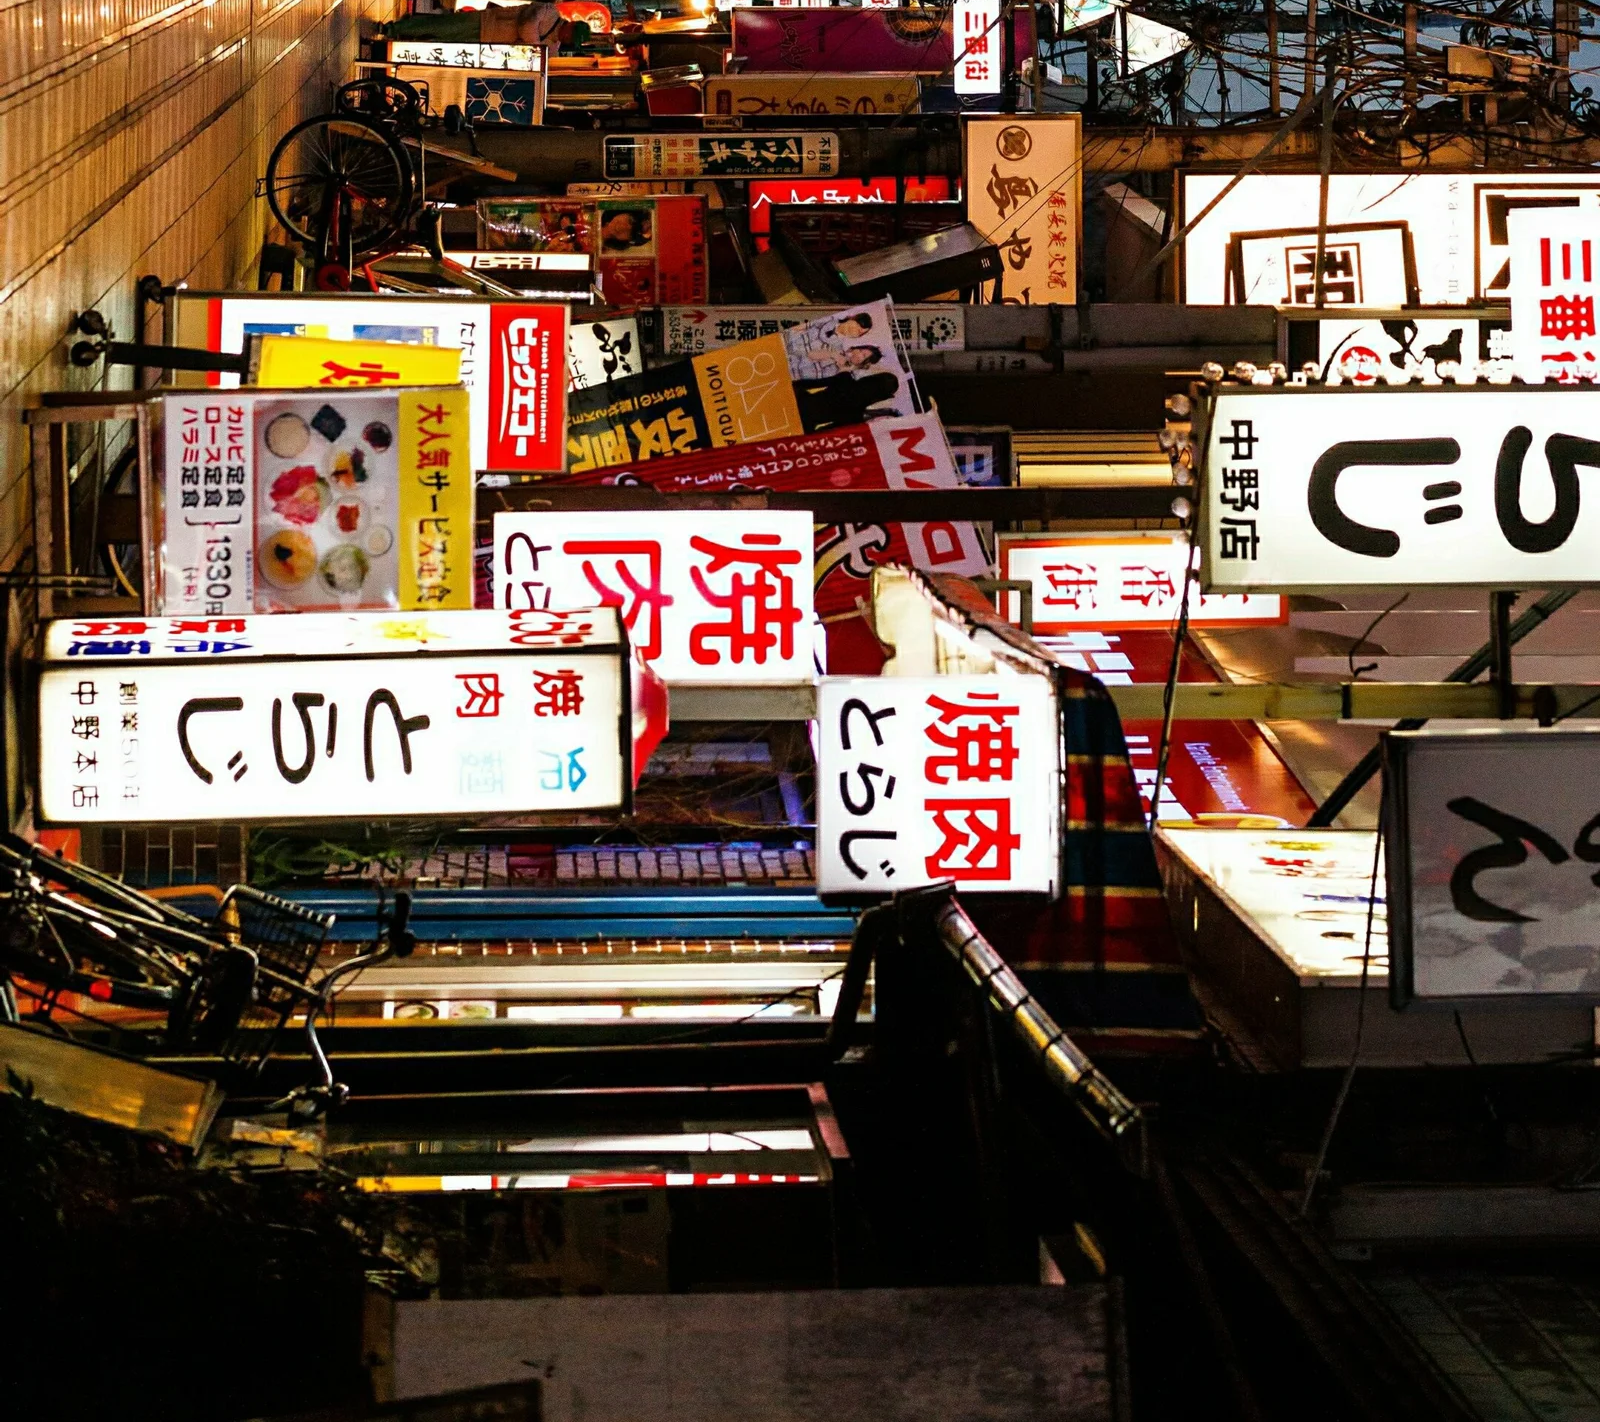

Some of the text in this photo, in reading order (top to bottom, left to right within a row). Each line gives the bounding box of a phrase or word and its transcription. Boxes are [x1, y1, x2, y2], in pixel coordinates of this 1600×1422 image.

[396, 48, 475, 68] 好味亭
[965, 12, 989, 81] 三番街
[708, 138, 800, 167] マツザキ
[819, 136, 832, 174] 不動産
[985, 164, 1039, 304] 鳥や
[508, 318, 539, 456] ビッグエコー
[539, 331, 550, 443] Karaoke Entertainment
[181, 407, 199, 509] ハラミ定食
[204, 406, 221, 509] ロース定食
[226, 406, 245, 509] カルビ定食
[416, 403, 451, 603] 大人気サービス定食
[1220, 420, 1259, 560] 中野店
[205, 535, 232, 616] 1330円
[563, 533, 803, 665] 焼肉
[1042, 564, 1251, 610] 番街
[70, 681, 100, 808] 中野本店
[177, 689, 430, 784] とらじ
[454, 669, 584, 718] 焼肉
[840, 699, 897, 880] とらじ
[924, 692, 1021, 885] 焼肉
